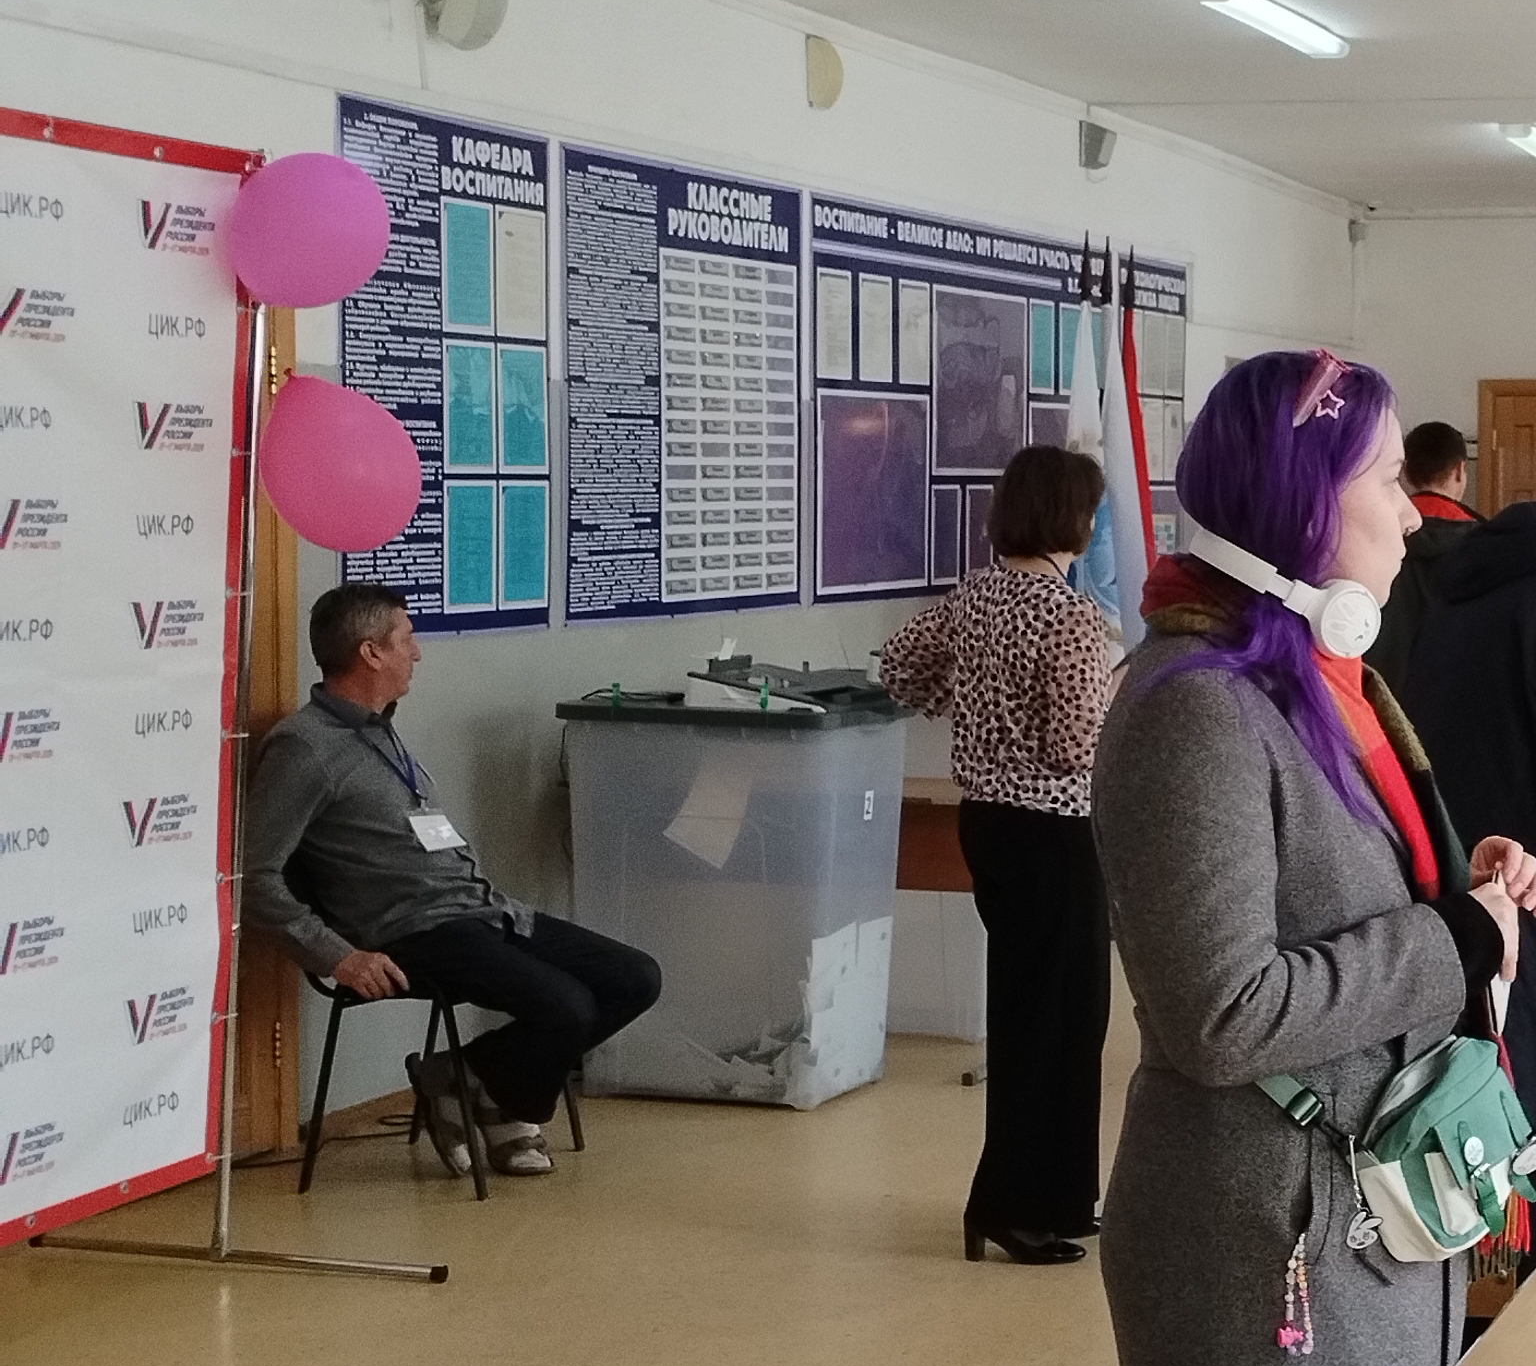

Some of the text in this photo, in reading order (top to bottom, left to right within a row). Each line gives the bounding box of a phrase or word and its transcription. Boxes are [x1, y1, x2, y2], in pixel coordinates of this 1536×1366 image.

[452, 135, 535, 176] КАФЕДРА
[441, 166, 544, 206] ВОСПИТАНИЯ
[687, 182, 772, 221] КЛАССНЫЕ
[668, 208, 789, 253] РУКОВОДИТЕЛИ
[814, 205, 888, 239] ВОСПИТАНИЕ
[897, 221, 944, 248] ВЕЛИКОЕ
[148, 313, 206, 340] ЦИК.РФ
[0, 405, 52, 431] ИК.РФ
[136, 514, 194, 540] ЦИК.РФ
[135, 708, 193, 738] ЦИК.РФ
[132, 903, 188, 936] ЦИК.РФ
[122, 1091, 179, 1129] ЦИК.РФ
